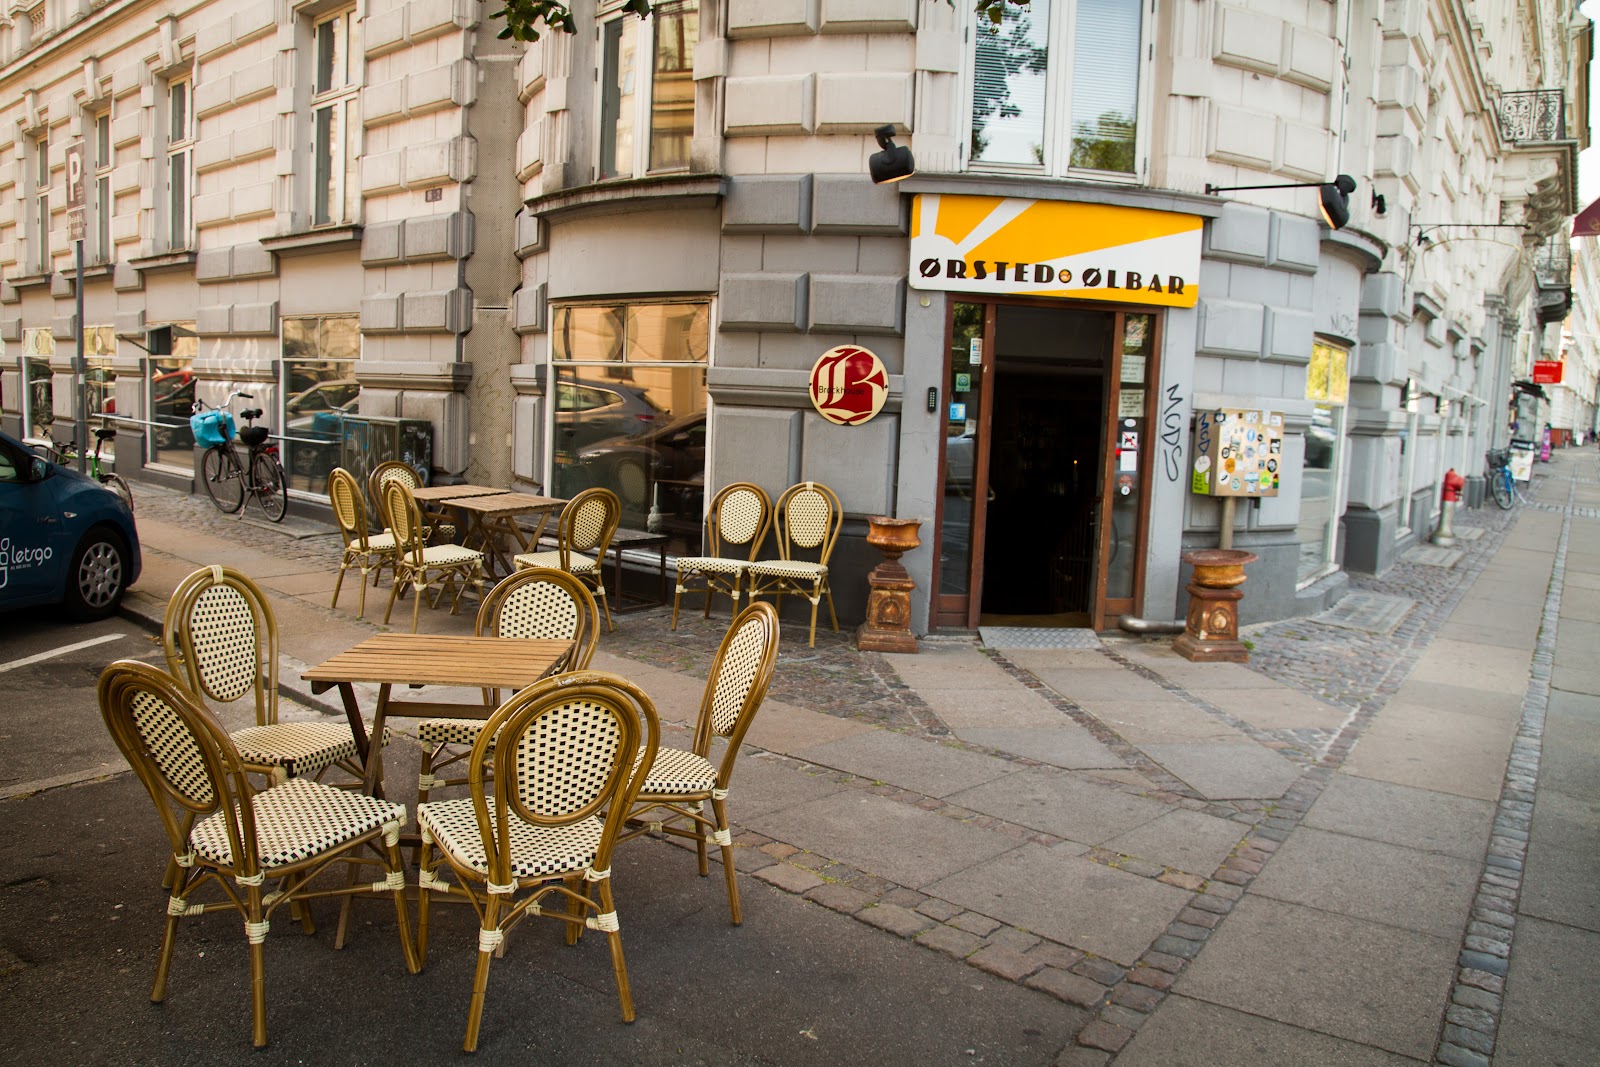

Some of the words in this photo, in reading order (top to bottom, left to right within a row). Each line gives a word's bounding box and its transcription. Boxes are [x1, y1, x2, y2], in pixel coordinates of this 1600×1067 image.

[70, 152, 81, 202] P
[919, 258, 1055, 284] ØRSTED
[1082, 267, 1185, 295] ØLBAR
